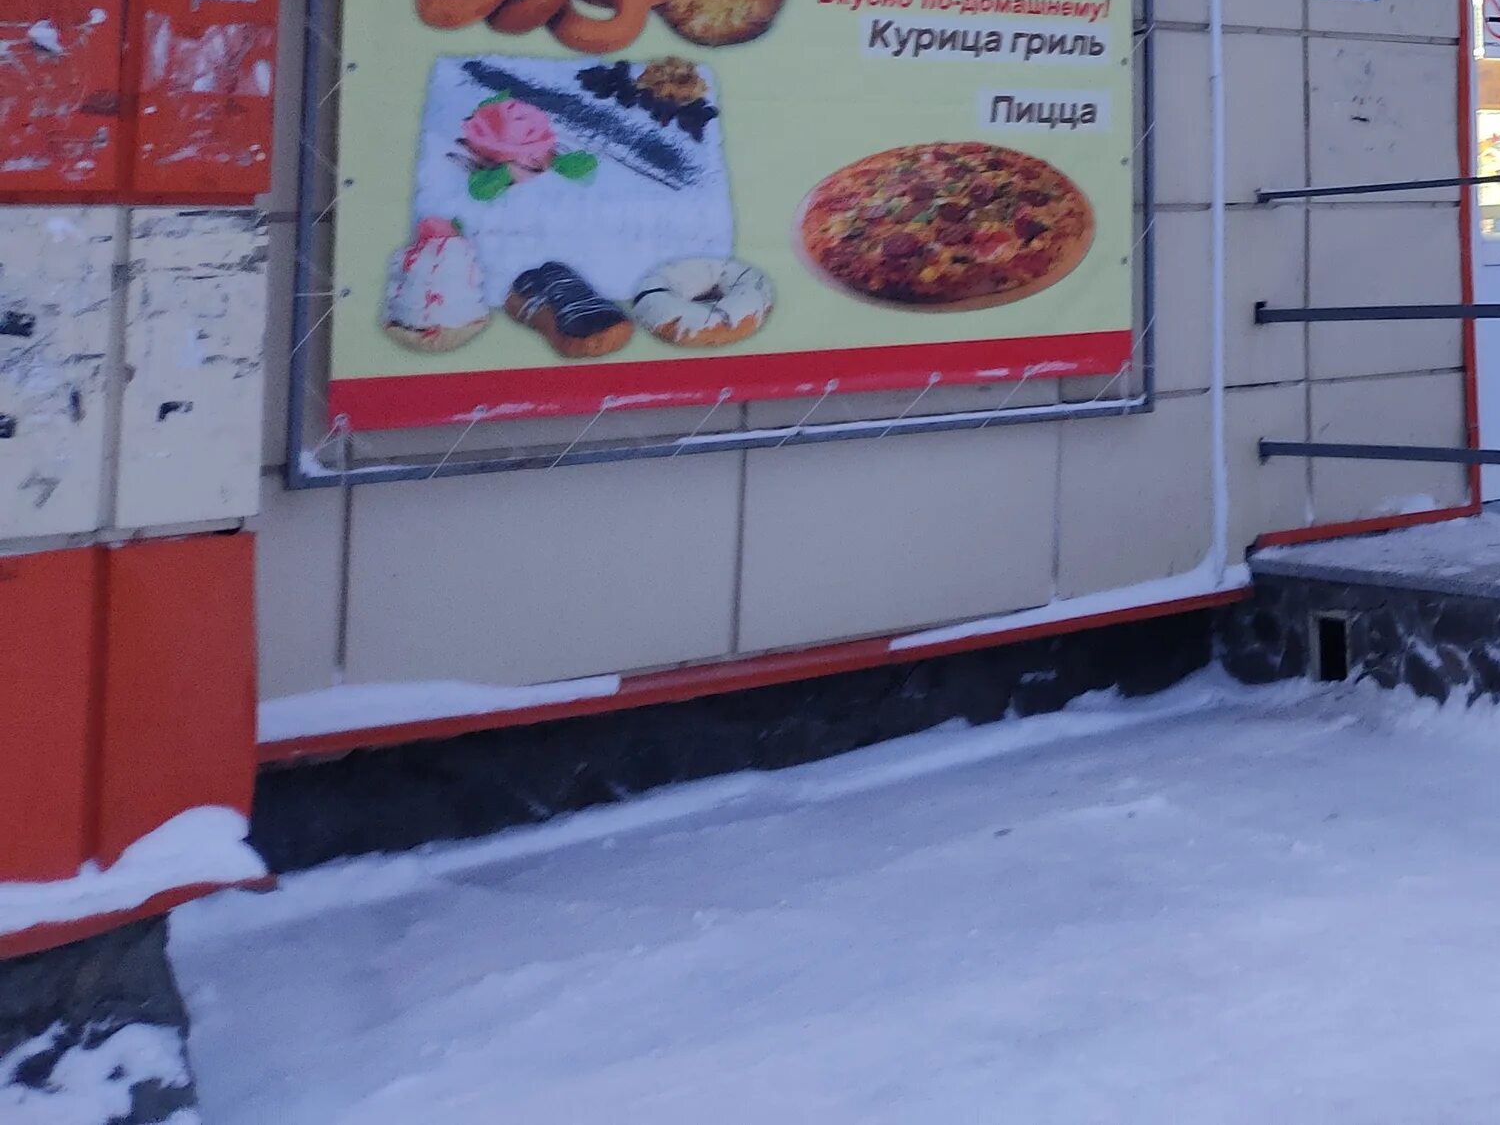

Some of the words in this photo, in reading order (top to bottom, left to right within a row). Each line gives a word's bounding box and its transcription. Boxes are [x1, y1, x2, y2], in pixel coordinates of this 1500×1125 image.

[867, 18, 1004, 59] Курица
[1009, 29, 1106, 61] гриль
[989, 94, 1098, 130] Пицца
